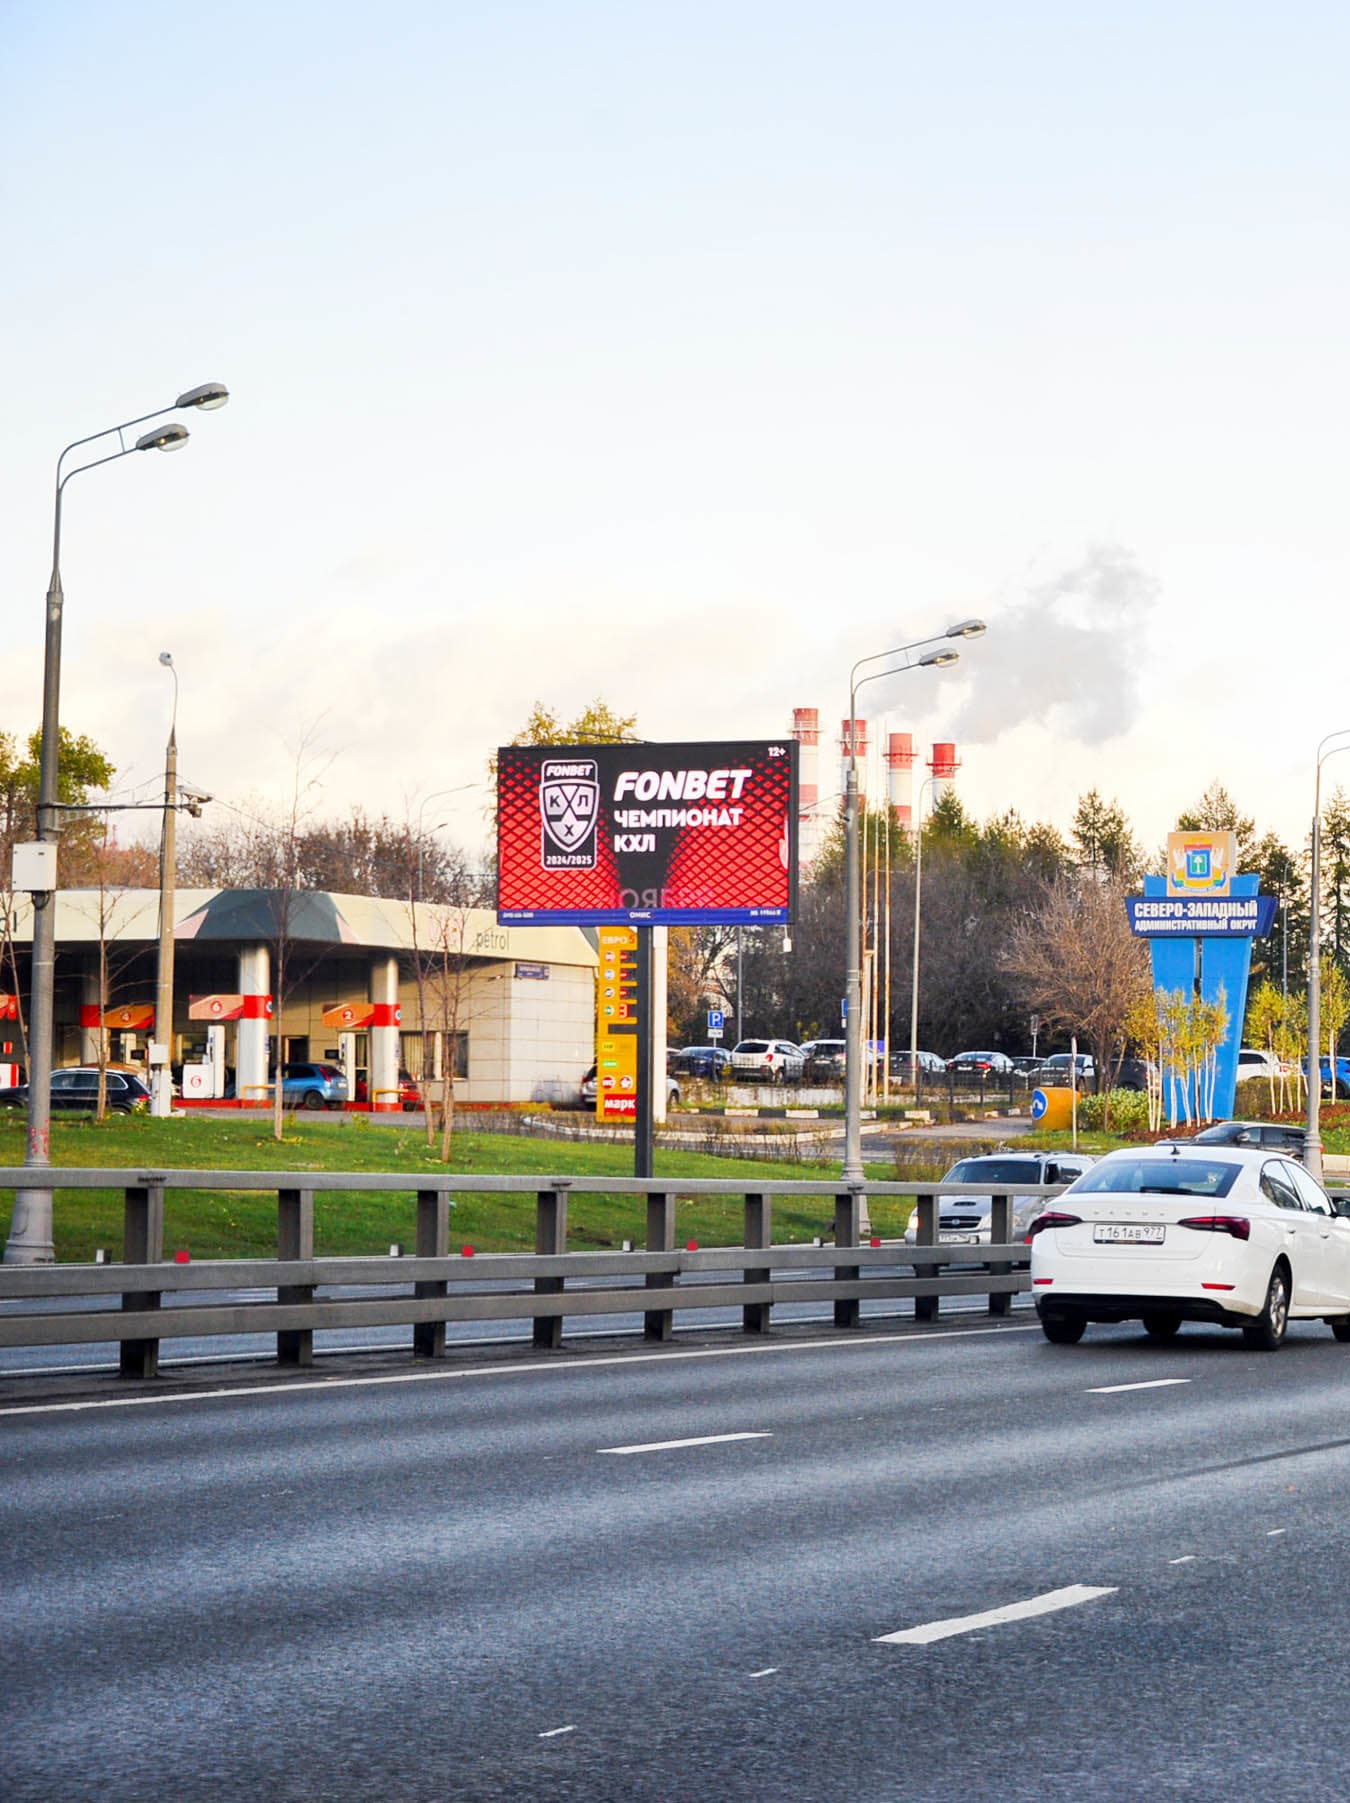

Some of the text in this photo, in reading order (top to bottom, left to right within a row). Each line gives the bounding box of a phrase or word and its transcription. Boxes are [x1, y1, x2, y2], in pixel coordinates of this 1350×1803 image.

[768, 747, 786, 757] 12+
[546, 764, 593, 776] FONBET
[613, 769, 753, 801] FONBET
[613, 808, 744, 828] ЧЕМПИОНАТ
[613, 834, 656, 852] КХЛ
[546, 855, 593, 865] 2024/2025
[1134, 900, 1258, 918] СЕВЕРО-ЗАПАДНЫЙ
[1135, 919, 1257, 931] АДМИНИСТРАТИВНЫЙ ОКРУГ
[476, 929, 510, 953] petrol
